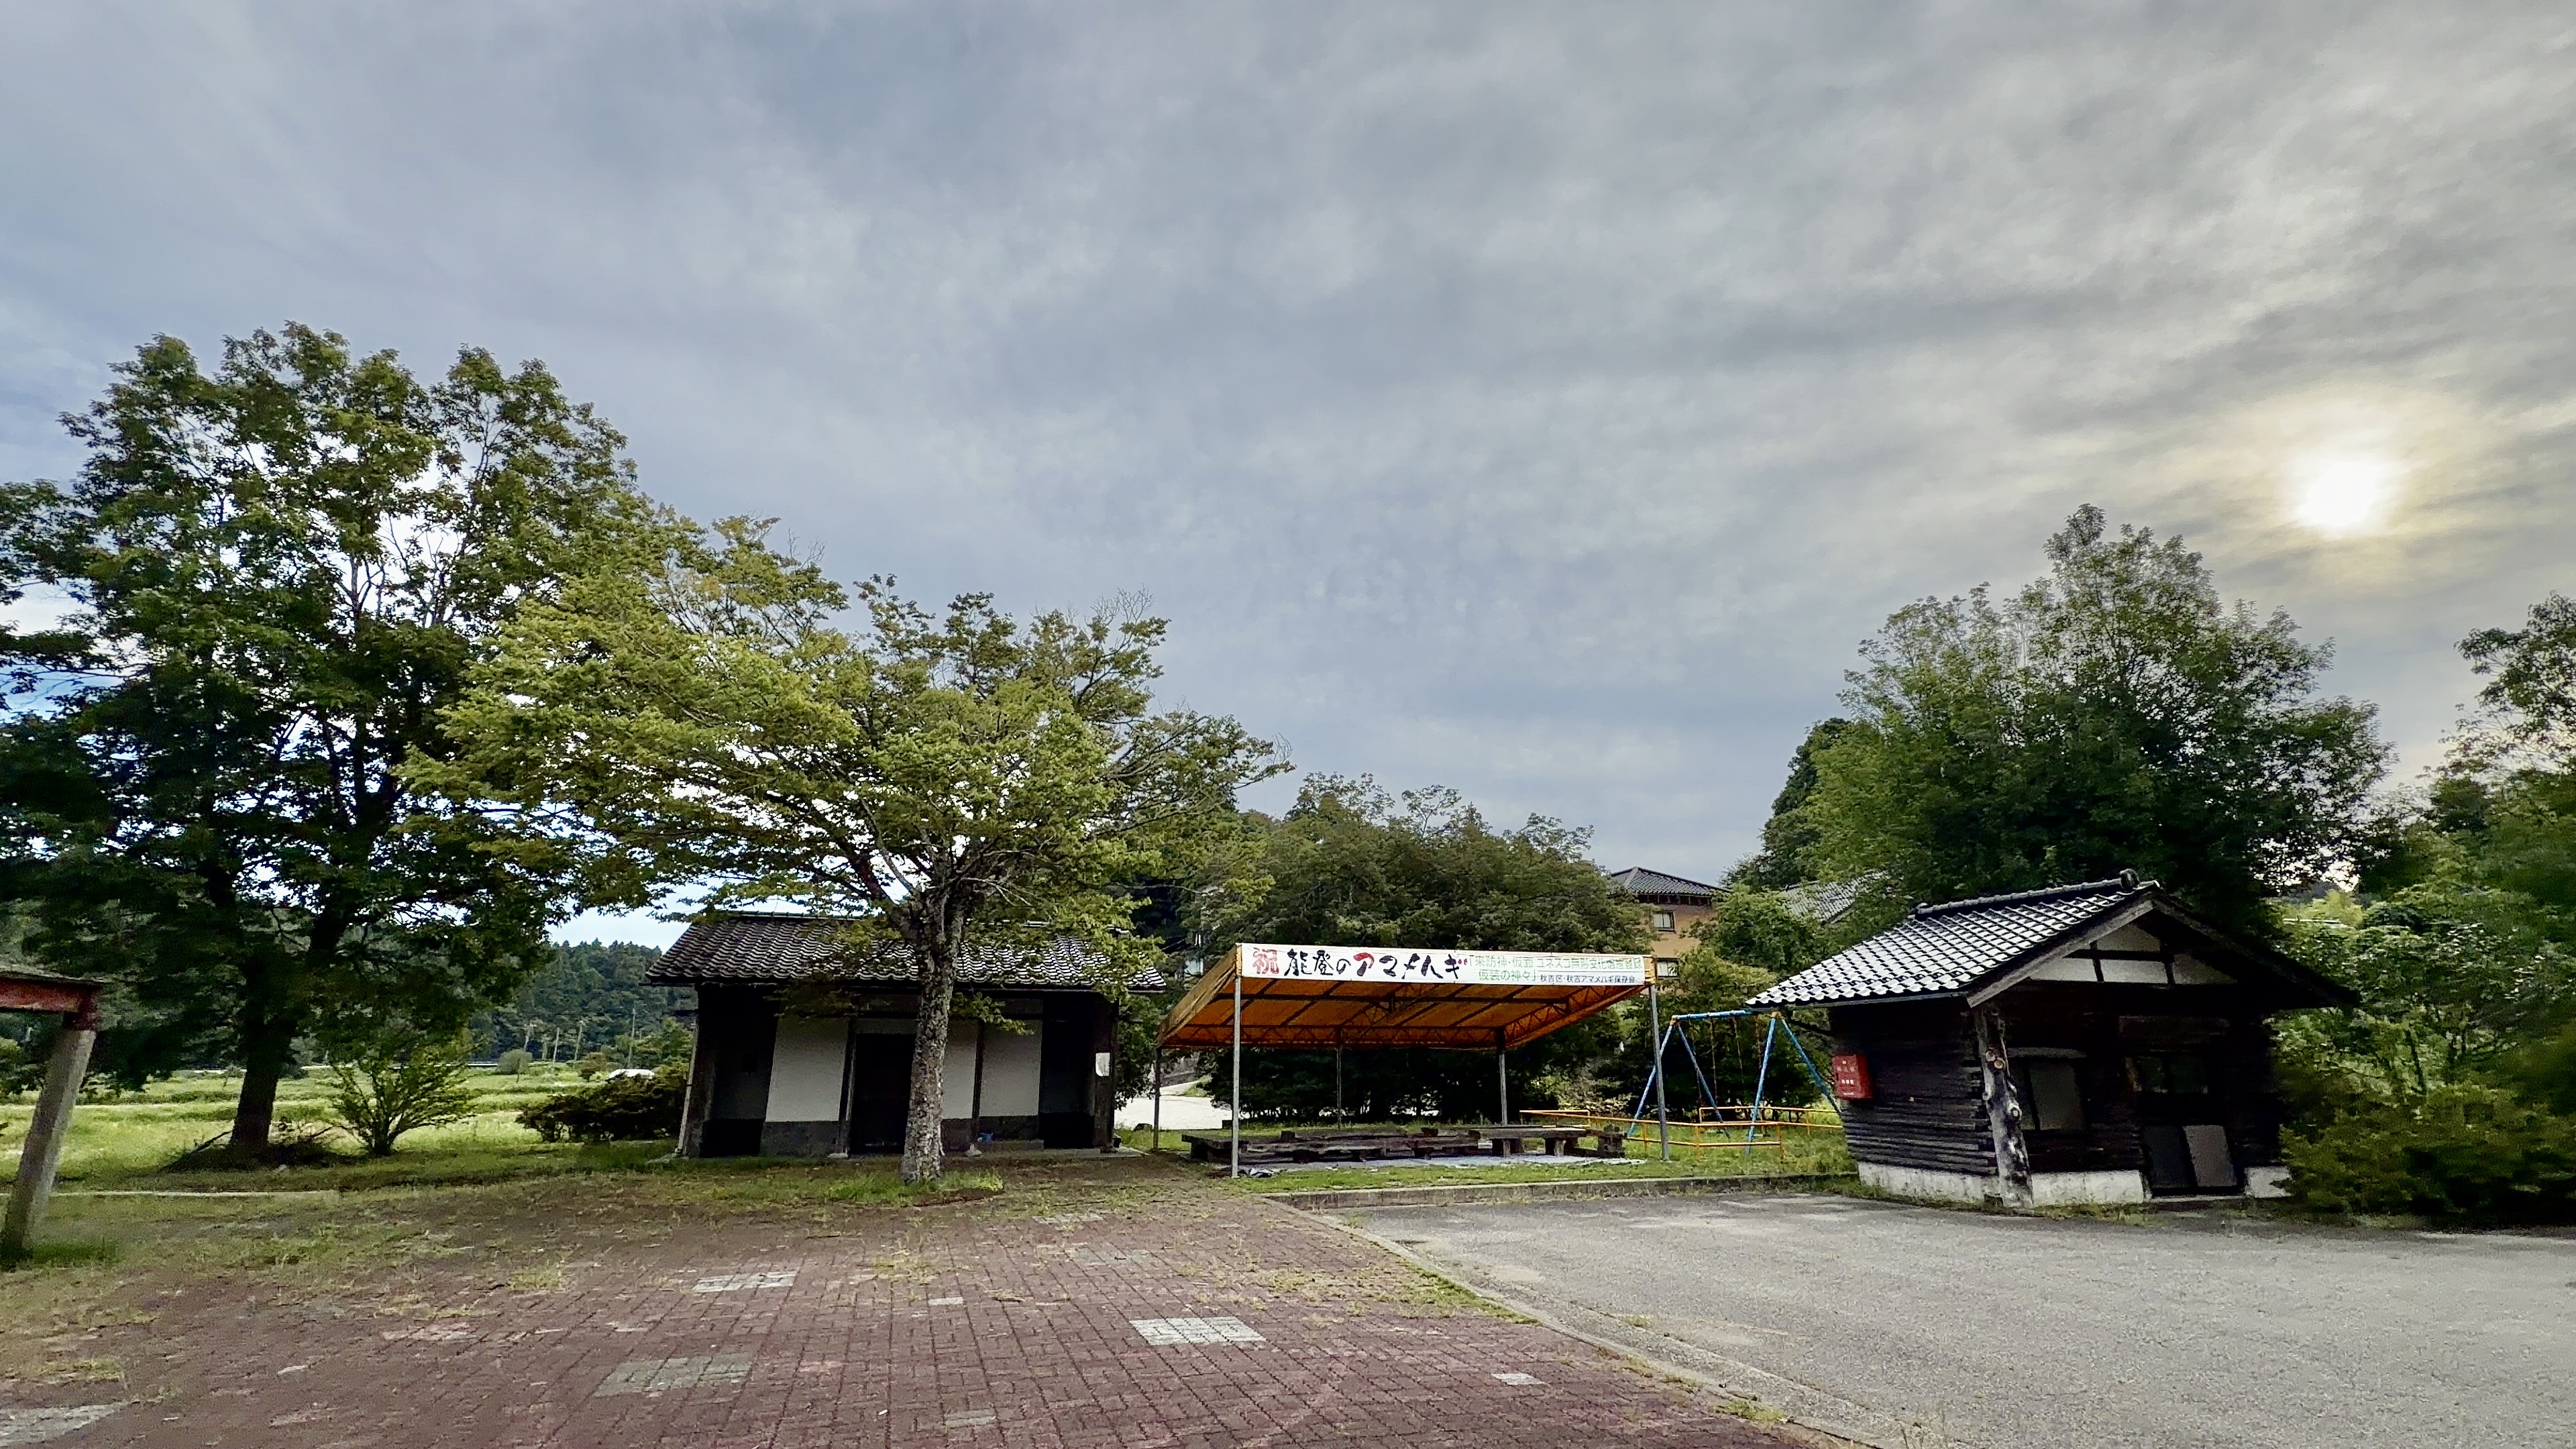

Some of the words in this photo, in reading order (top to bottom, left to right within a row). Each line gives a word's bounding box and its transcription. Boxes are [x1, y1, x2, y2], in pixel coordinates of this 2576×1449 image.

[1252, 947, 1279, 974] 祝
[1284, 949, 1468, 979] 能登のアマメハギ
